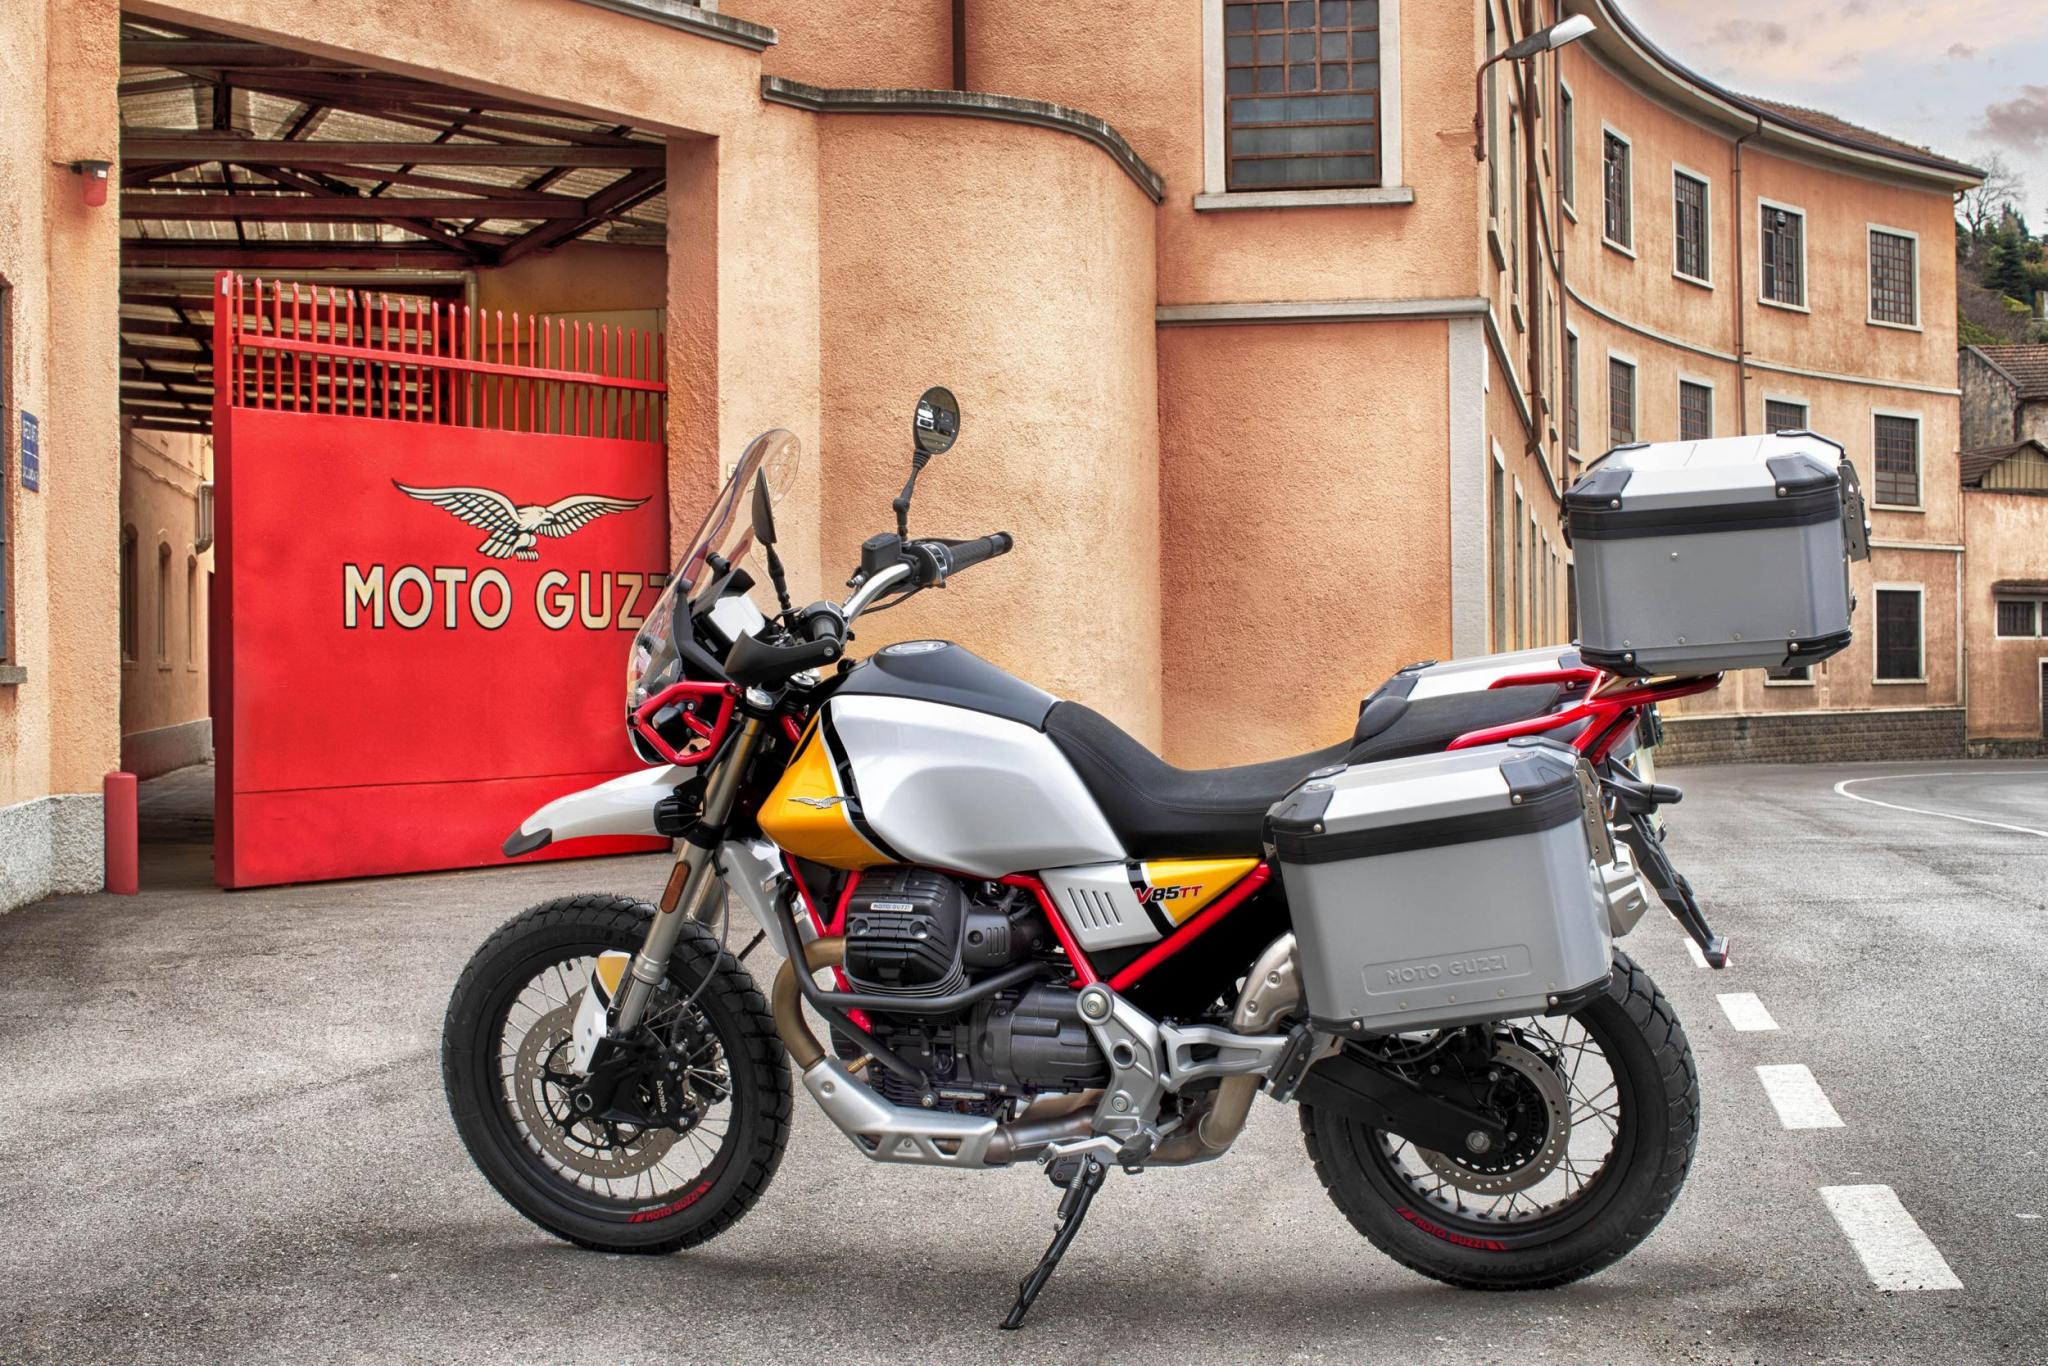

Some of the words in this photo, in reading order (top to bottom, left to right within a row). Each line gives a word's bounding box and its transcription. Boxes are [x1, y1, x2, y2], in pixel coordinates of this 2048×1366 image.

[343, 563, 512, 630] MOTO
[1135, 885, 1203, 904] V85TT
[1385, 963, 1442, 985] MOTO
[1448, 953, 1508, 976] GUZZI
[656, 1080, 667, 1113] brembo
[646, 1206, 672, 1221] MOTO
[1415, 1218, 1447, 1240] MOTO
